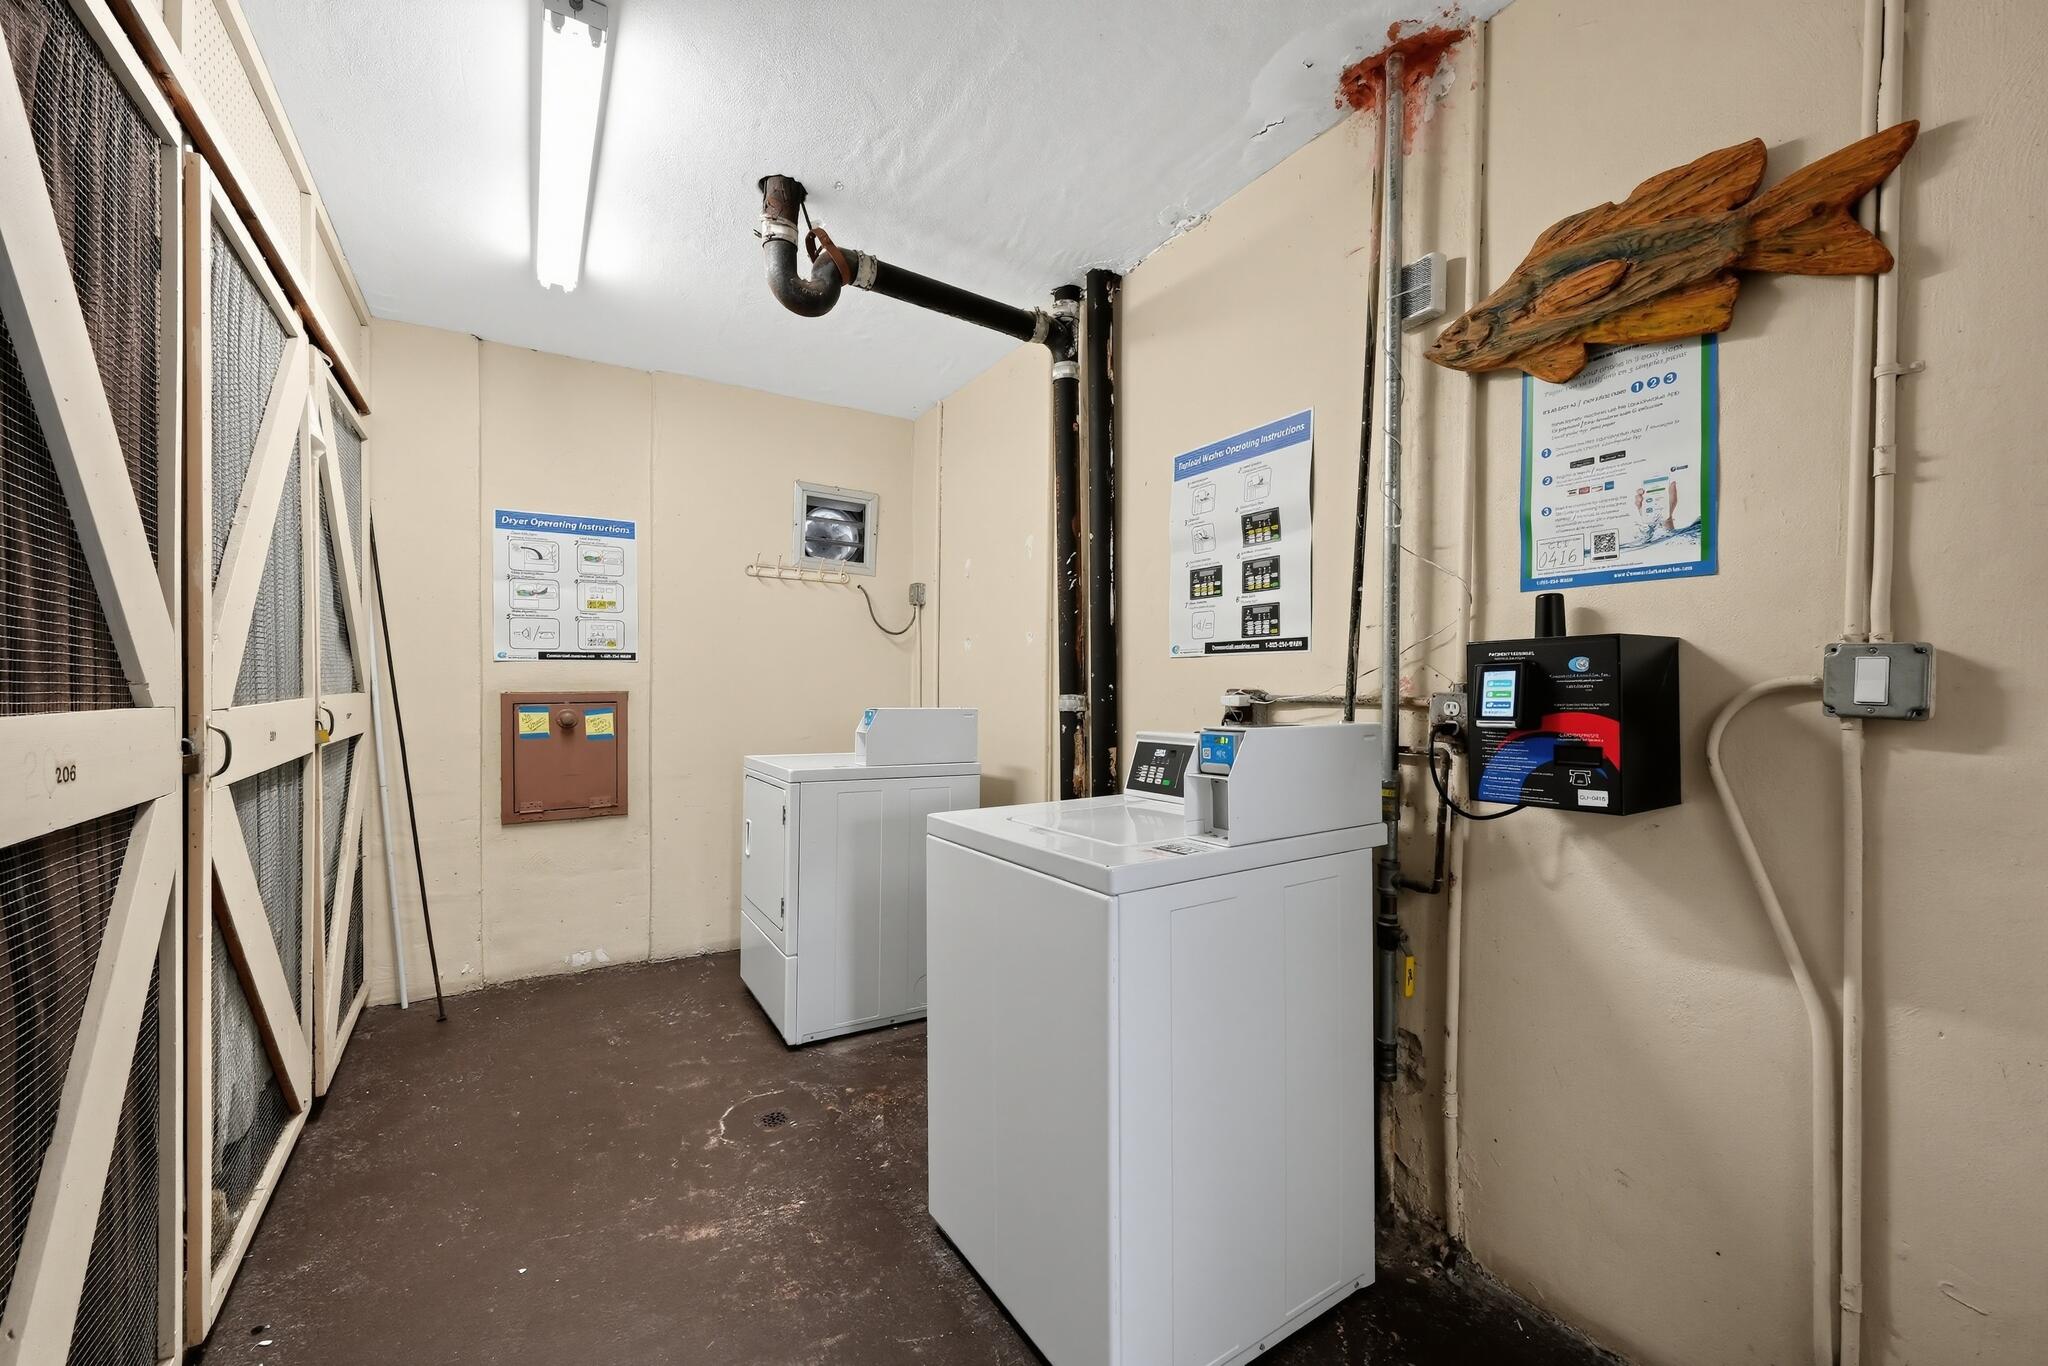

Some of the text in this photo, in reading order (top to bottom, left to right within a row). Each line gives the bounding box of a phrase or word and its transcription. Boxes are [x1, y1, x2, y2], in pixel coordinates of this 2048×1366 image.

[1202, 450, 1225, 463] Washer
[1225, 438, 1260, 456] Operating
[1260, 423, 1305, 444] Instructions
[501, 516, 630, 533] Dryer Operating Instructions
[1538, 548, 1577, 568] 0416
[55, 764, 76, 784] 206
